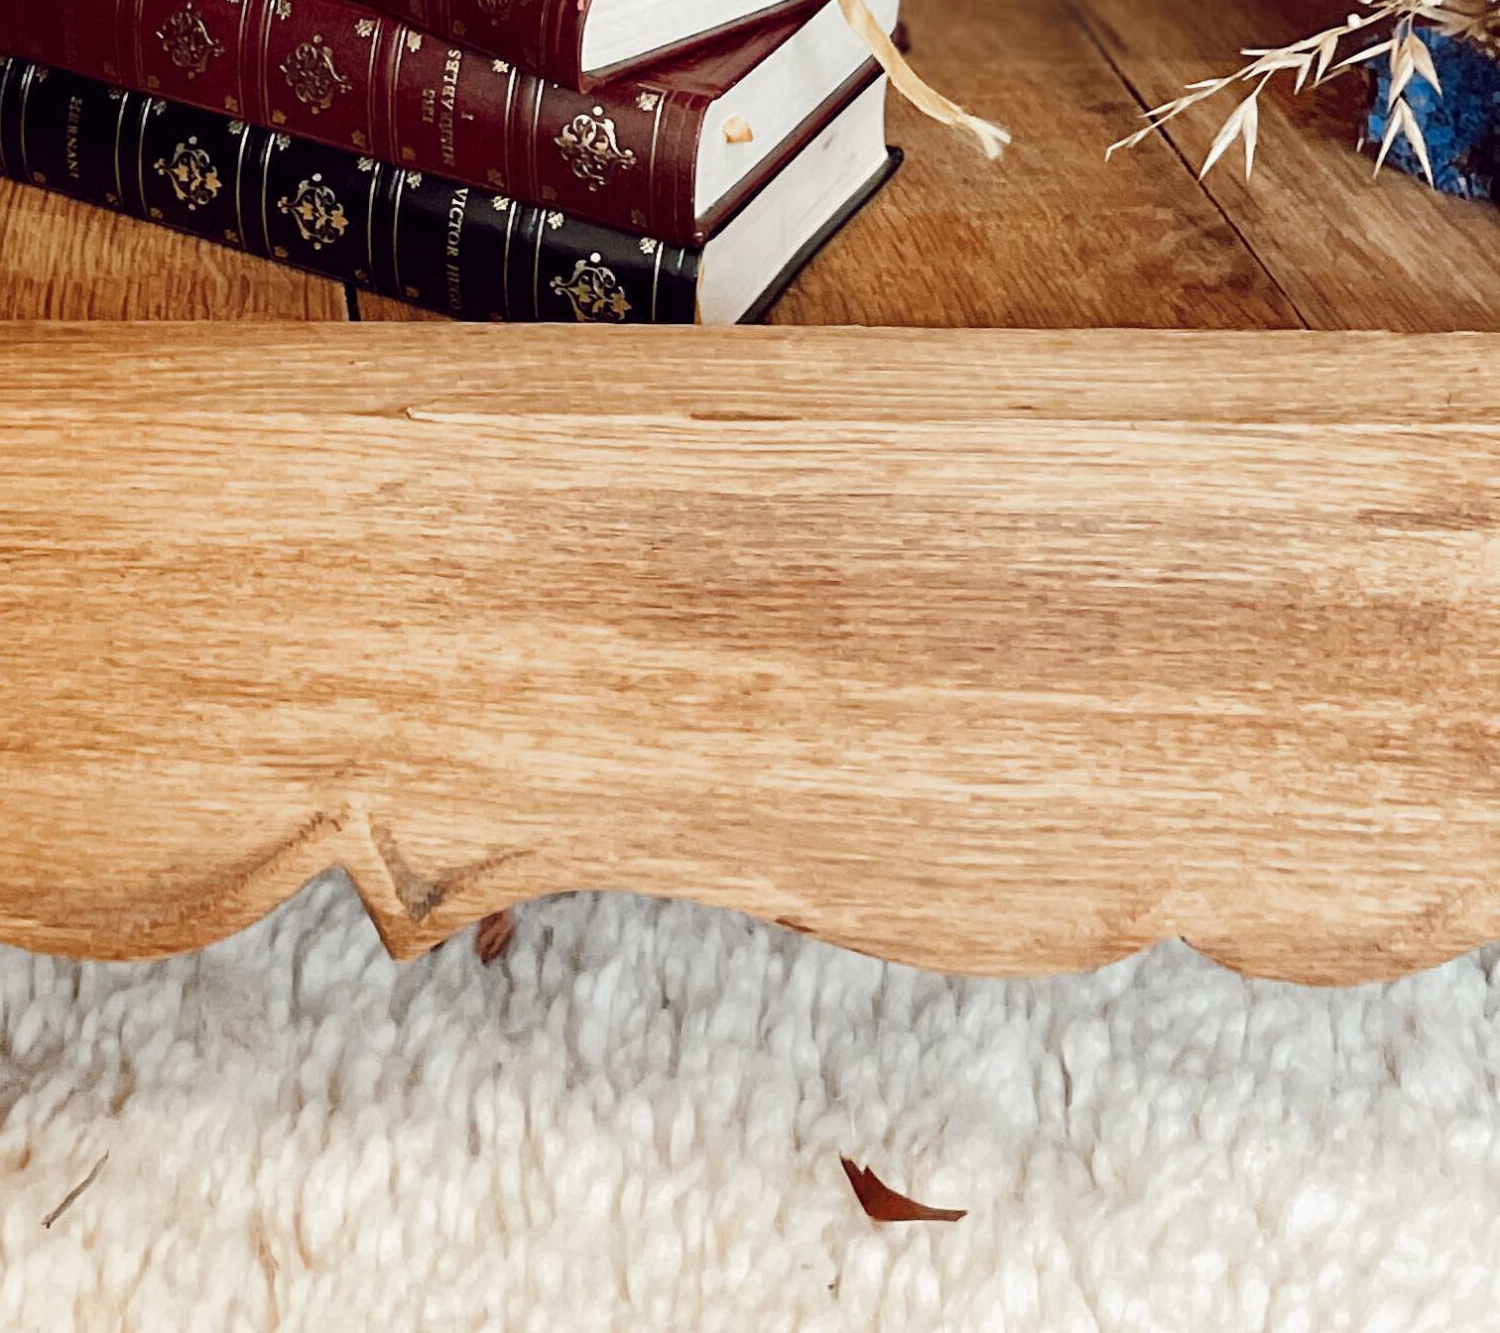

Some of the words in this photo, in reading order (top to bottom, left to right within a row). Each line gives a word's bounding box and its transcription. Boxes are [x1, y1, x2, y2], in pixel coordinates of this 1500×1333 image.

[67, 96, 83, 180] HERNANI
[446, 187, 469, 257] VICTOR
[446, 263, 462, 310] HUGO
